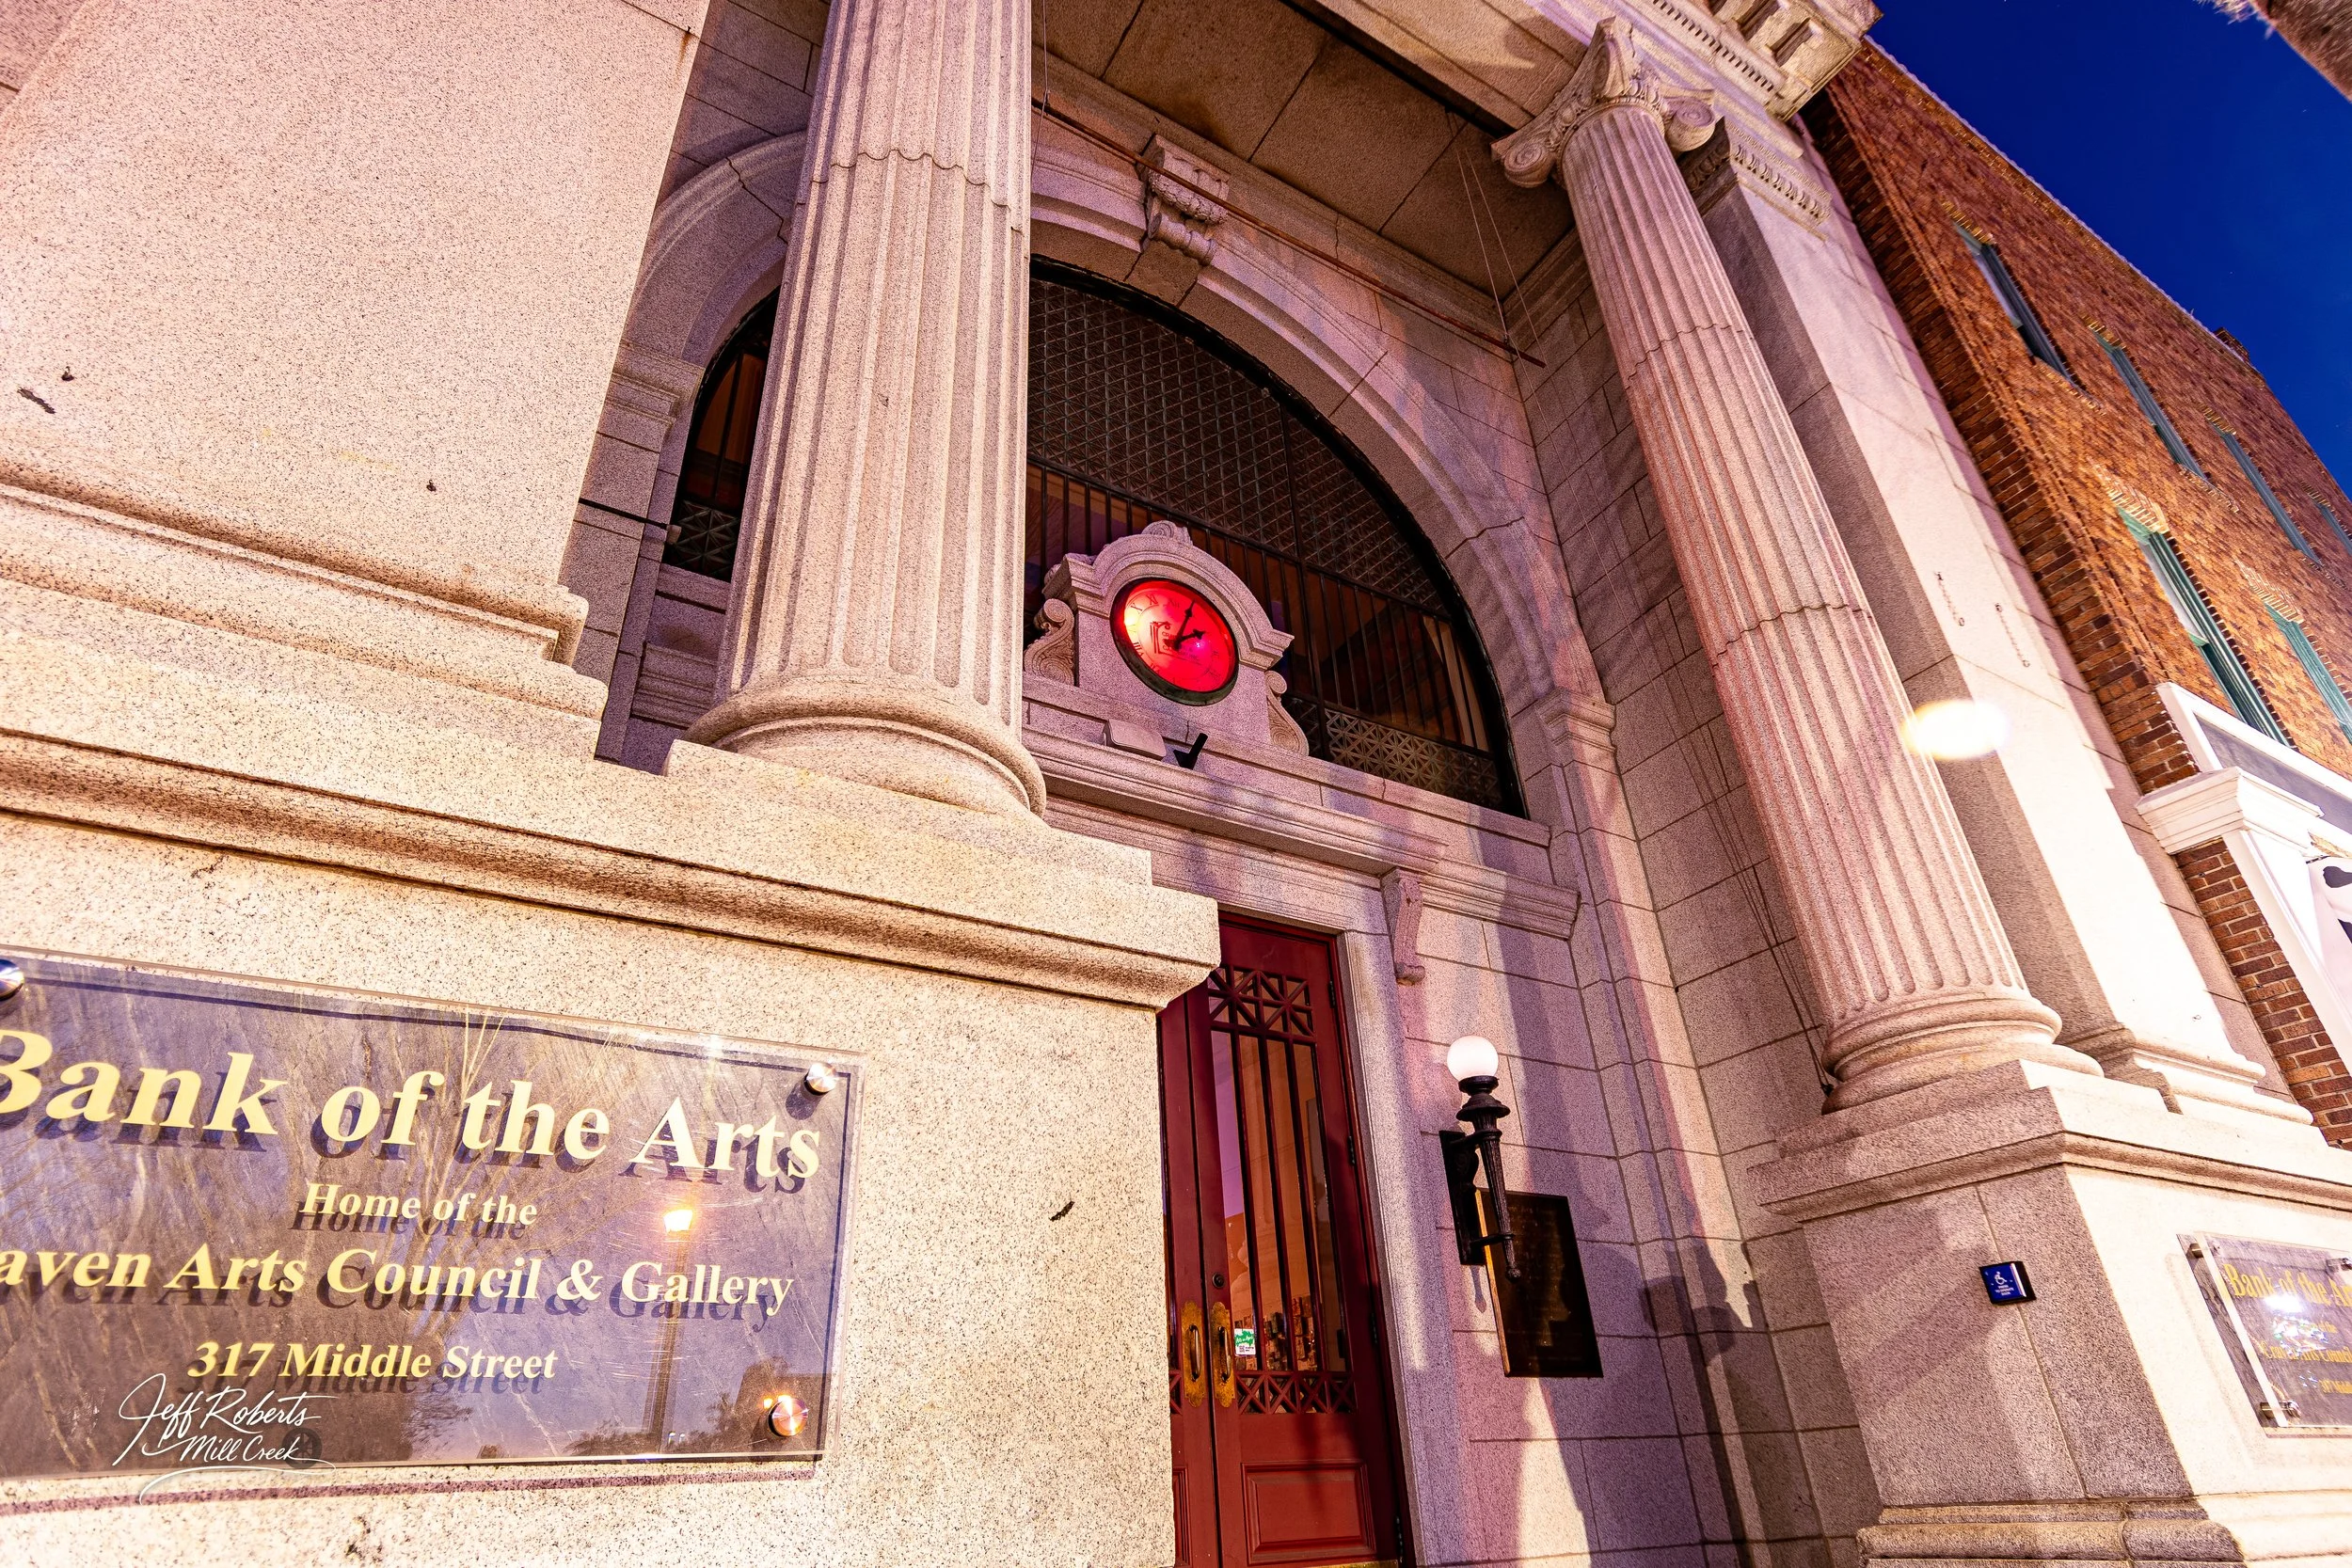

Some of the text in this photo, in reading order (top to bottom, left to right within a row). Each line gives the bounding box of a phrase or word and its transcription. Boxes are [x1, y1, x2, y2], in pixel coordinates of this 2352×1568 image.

[0, 1030, 820, 1179] Bank of the Arts
[299, 1183, 537, 1225] Home of the
[164, 1243, 308, 1293] Arts
[326, 1248, 541, 1299] Council
[555, 1259, 603, 1302] &
[621, 1261, 794, 1316] Gallery
[2223, 1263, 2275, 1299] Bank
[187, 1341, 558, 1379] 317 Middle Street
